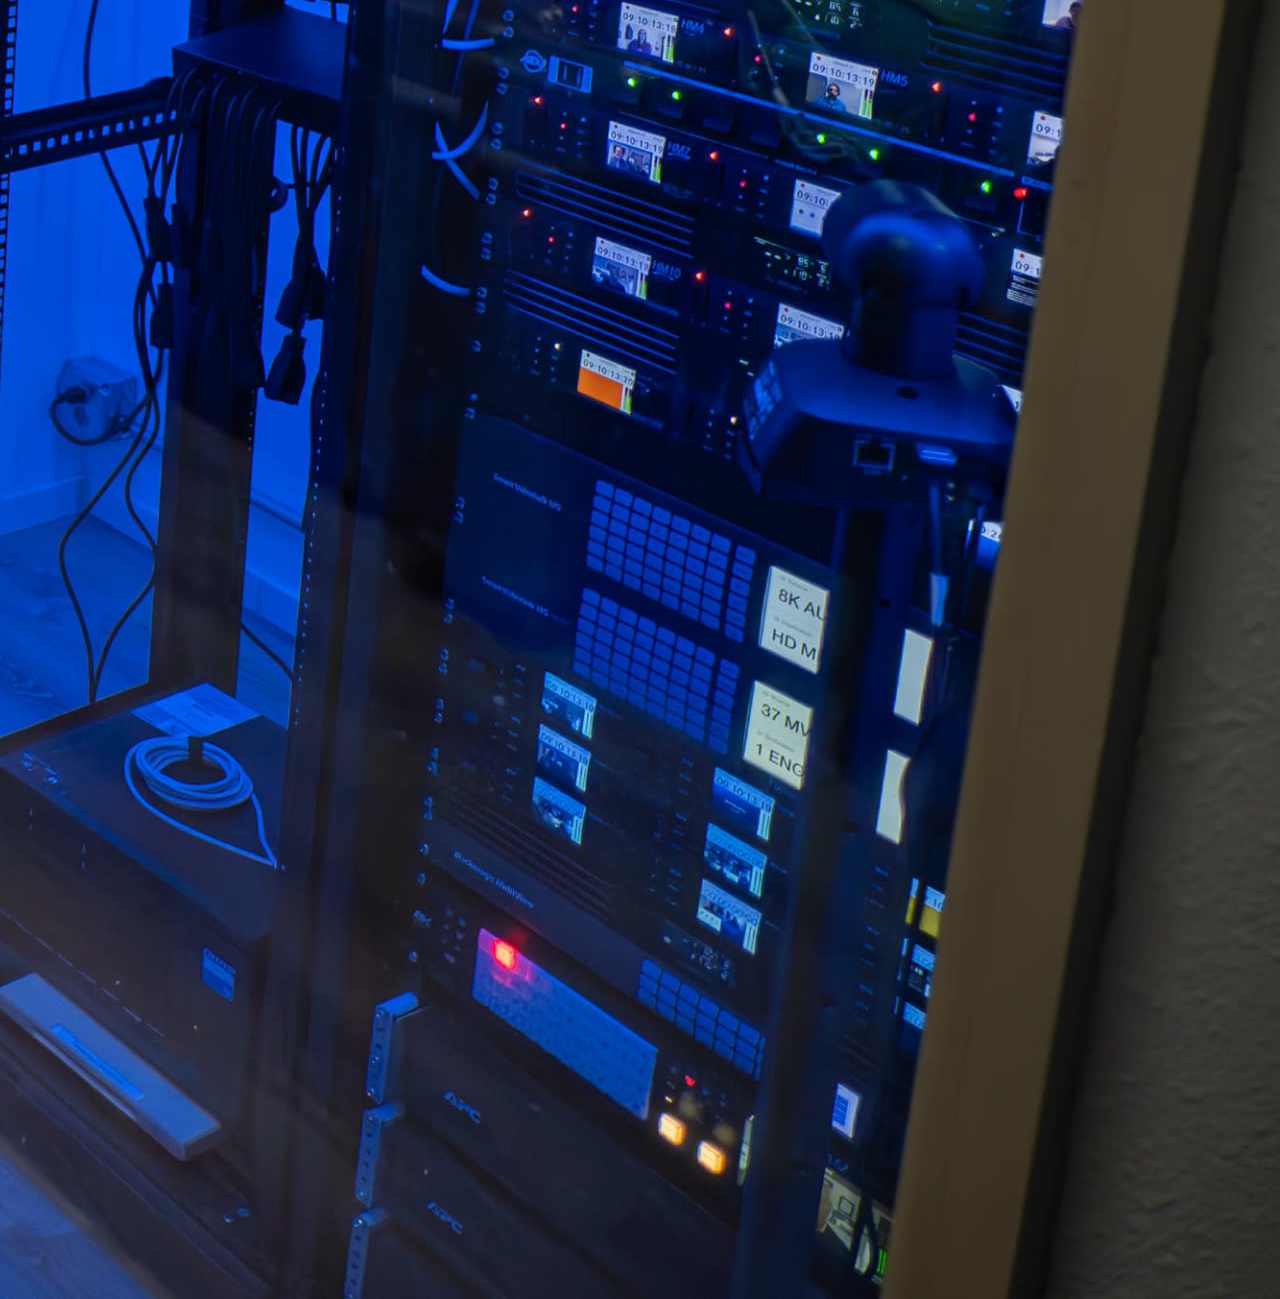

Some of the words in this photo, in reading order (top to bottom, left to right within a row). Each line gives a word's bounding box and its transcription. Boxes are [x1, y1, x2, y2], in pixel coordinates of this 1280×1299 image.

[811, 62, 875, 87] 09:10:13:19
[777, 587, 801, 610] 8K
[771, 627, 797, 651] HD
[800, 642, 817, 661] M
[761, 702, 782, 722] 37
[755, 742, 764, 757] 1
[443, 1089, 481, 1124] APC
[426, 1200, 463, 1235] APC
